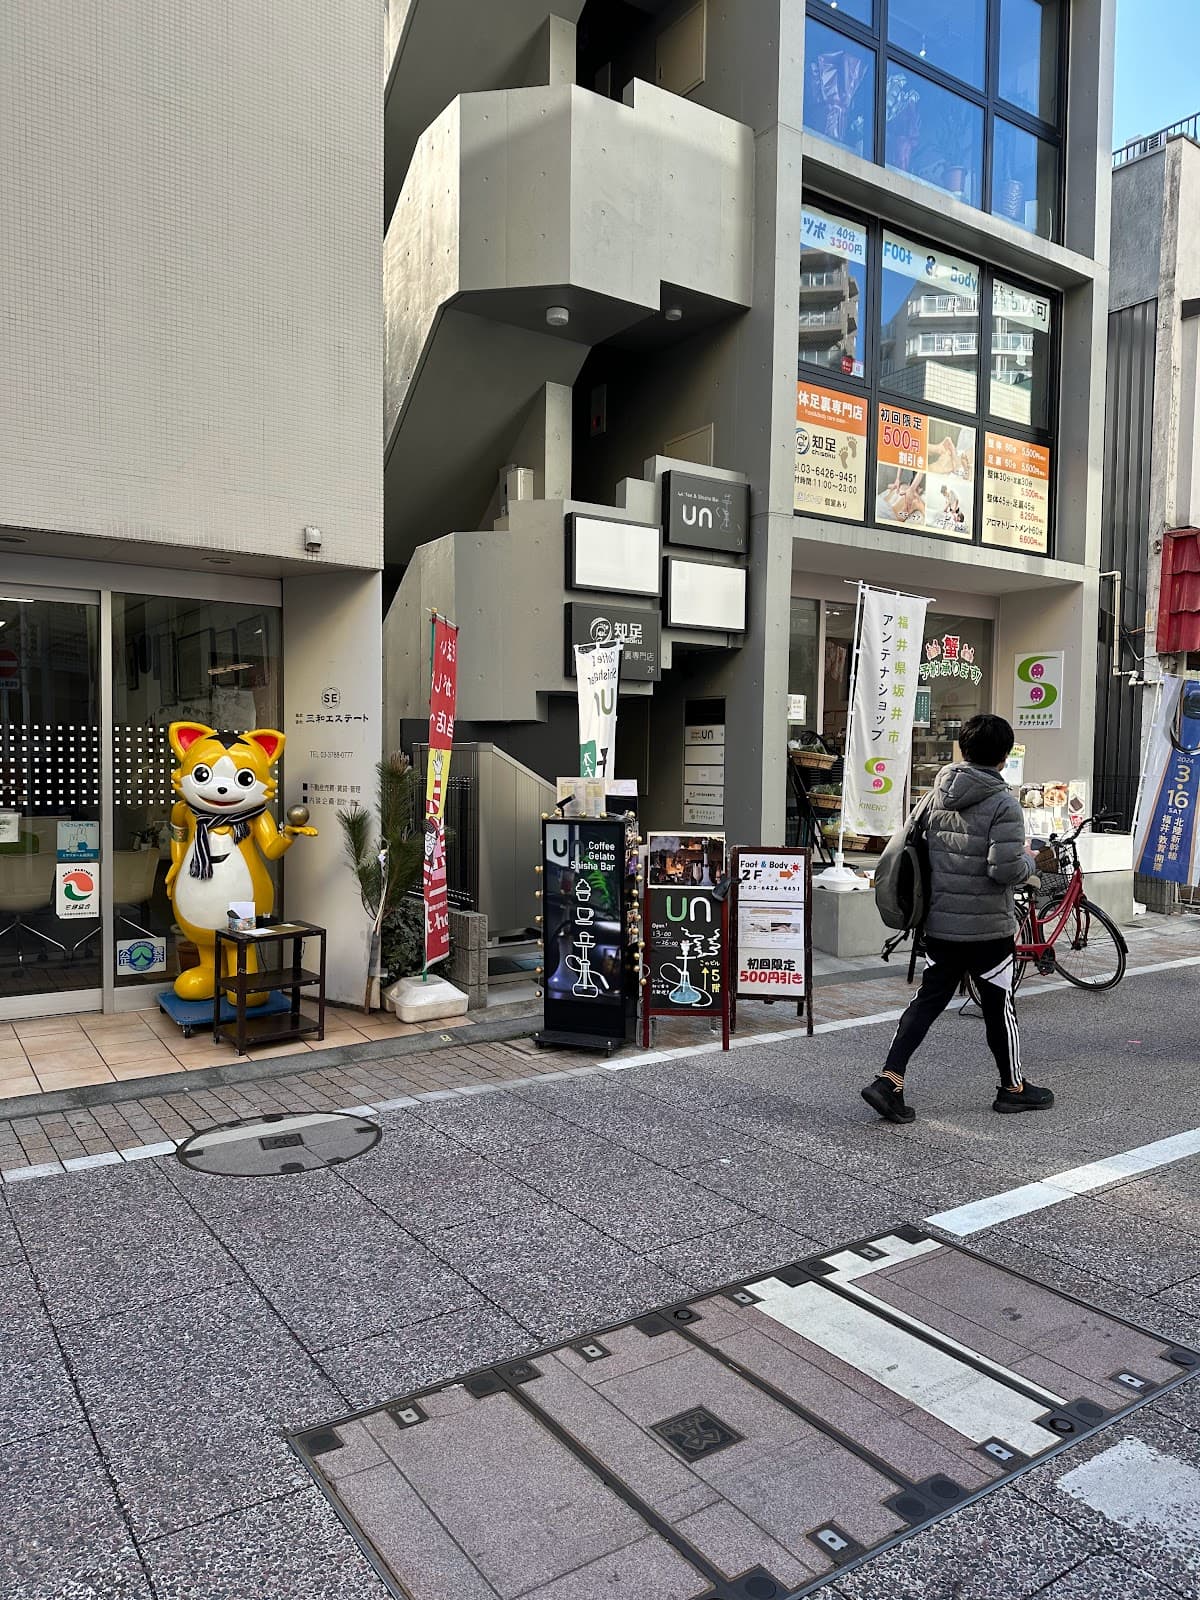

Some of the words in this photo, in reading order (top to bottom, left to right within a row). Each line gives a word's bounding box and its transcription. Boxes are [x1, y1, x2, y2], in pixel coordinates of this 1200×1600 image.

[836, 226, 856, 242] 40分
[830, 236, 863, 256] 3300円
[880, 407, 922, 431] 初回限定
[812, 435, 836, 453] 知足
[883, 426, 920, 453] 500円
[682, 503, 713, 529] un
[614, 621, 643, 638] 知足
[871, 613, 894, 741] アンテナショップ
[888, 615, 909, 744] 福井県坂井市
[323, 693, 338, 703] SE
[305, 712, 369, 723] 三和エステート
[1168, 807, 1182, 815] SAT
[588, 840, 616, 851] Coffee
[588, 851, 616, 861] Gelato
[570, 860, 598, 871] Shisha
[600, 861, 616, 871] Bar
[740, 860, 758, 869] Foot
[760, 860, 767, 868] &
[769, 861, 789, 870] Body
[742, 869, 763, 881] 2F
[665, 895, 712, 923] un
[747, 957, 796, 971] 初回限定
[739, 970, 803, 984] 500円引き
